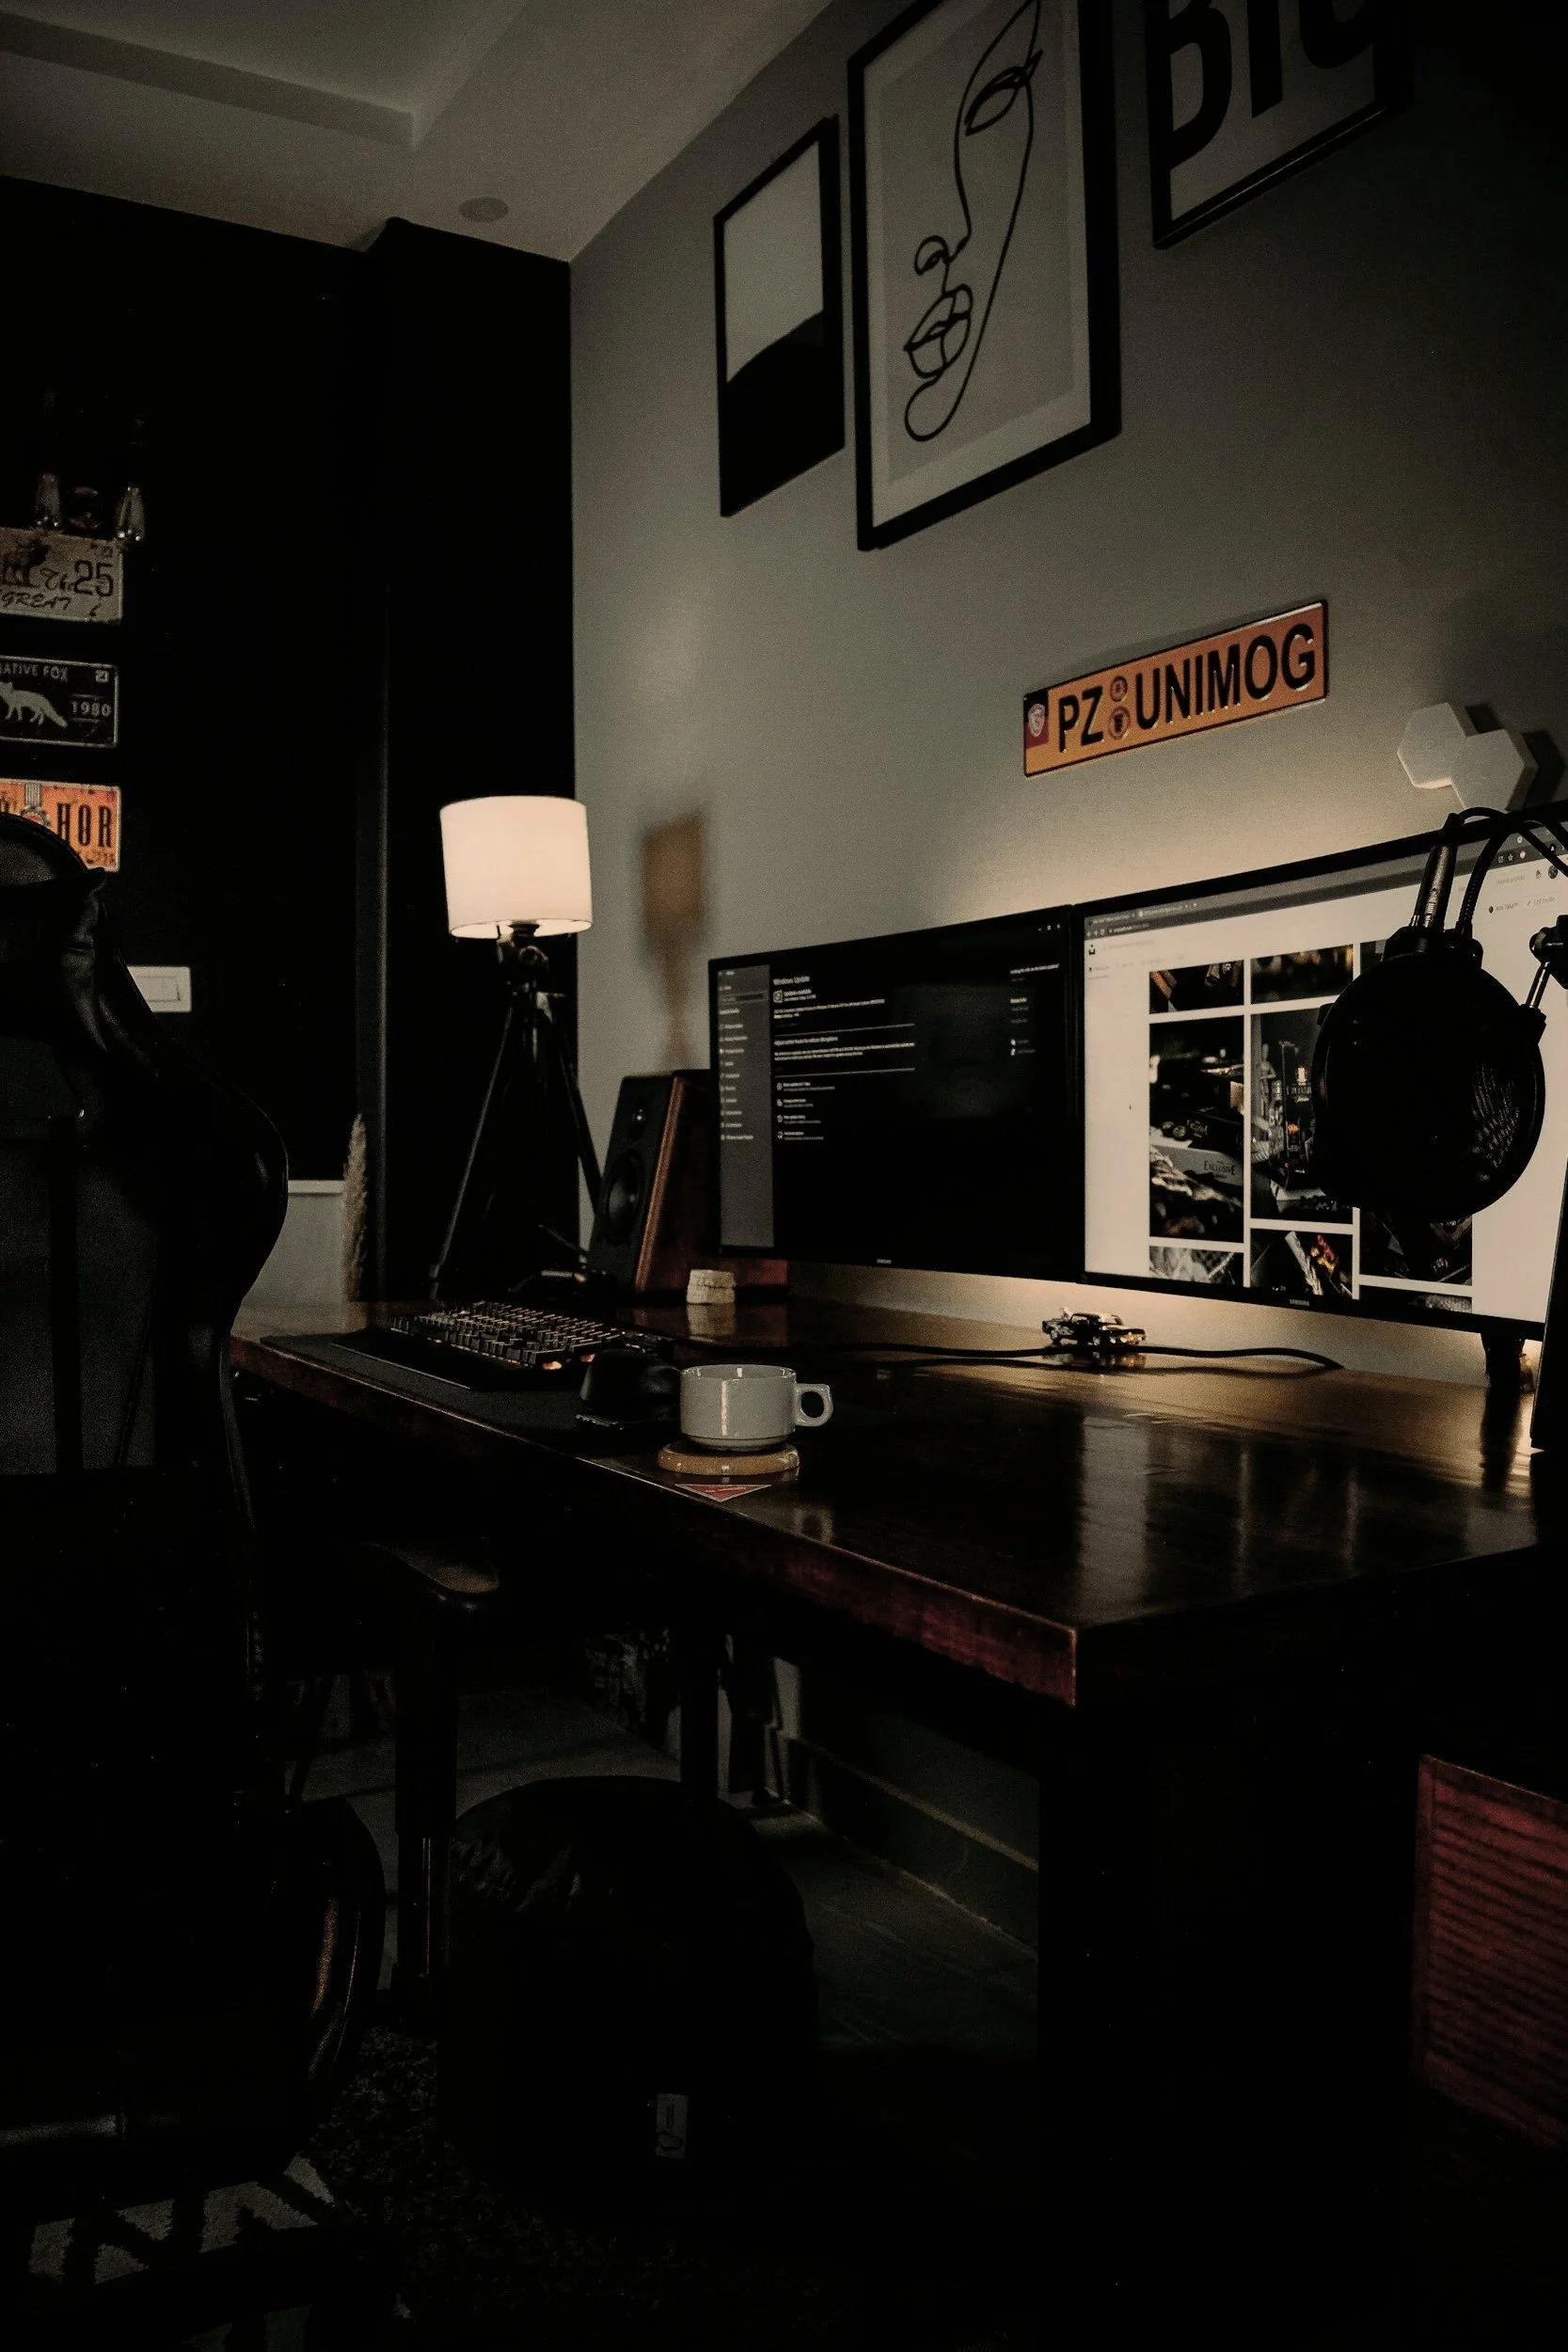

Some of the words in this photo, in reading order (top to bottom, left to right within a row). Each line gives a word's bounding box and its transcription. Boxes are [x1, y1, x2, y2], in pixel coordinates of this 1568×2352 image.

[74, 560, 113, 596] 25
[0, 662, 39, 677] ATIVE
[43, 665, 69, 683] FOX
[1059, 686, 1103, 753] PZ
[1136, 623, 1315, 730] UNIMOG
[71, 701, 112, 718] 1980
[56, 803, 112, 849] HOR
